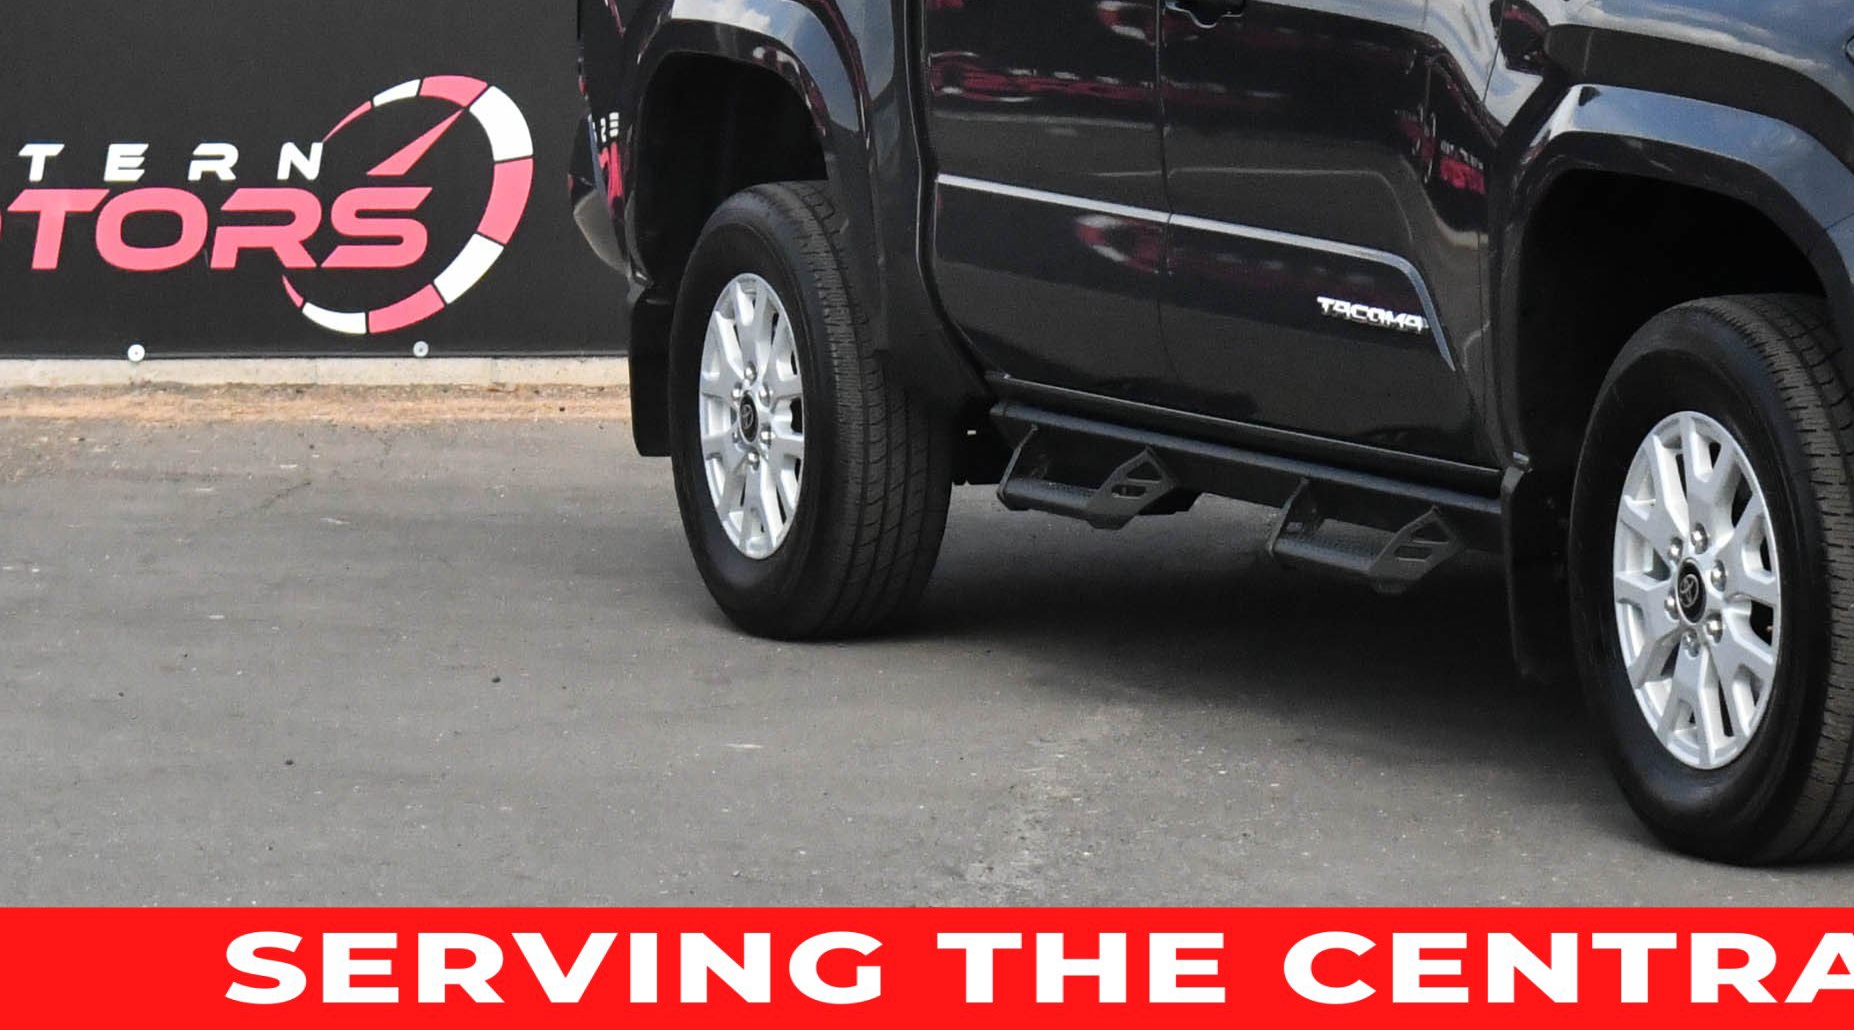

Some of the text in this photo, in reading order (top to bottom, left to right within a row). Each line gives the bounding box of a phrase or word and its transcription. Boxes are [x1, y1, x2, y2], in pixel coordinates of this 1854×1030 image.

[19, 142, 323, 181] TERN
[8, 187, 432, 271] TORS
[1317, 296, 1422, 334] TACOMA
